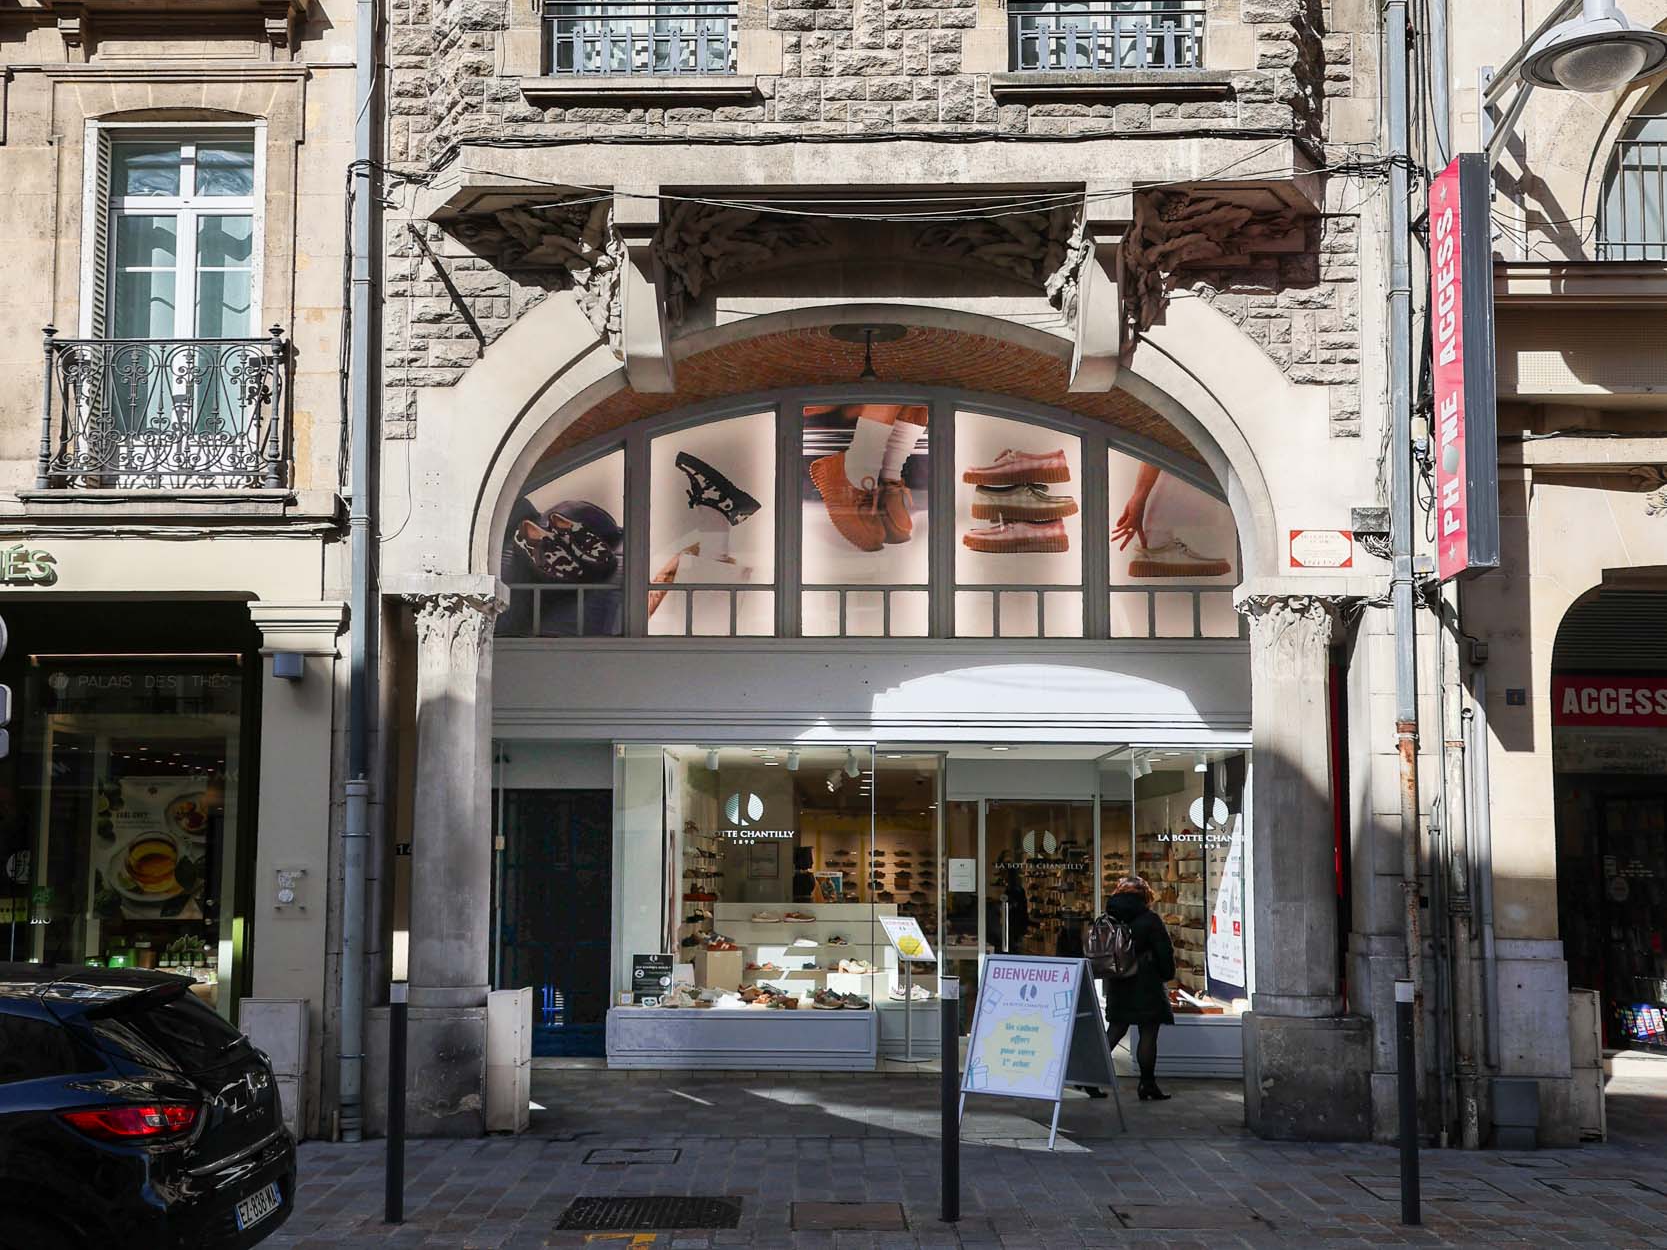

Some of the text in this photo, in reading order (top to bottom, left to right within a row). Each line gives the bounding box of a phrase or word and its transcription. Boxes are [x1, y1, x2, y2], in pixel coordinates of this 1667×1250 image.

[1436, 207, 1457, 367] ACCESS
[0, 543, 50, 579] ÉS
[78, 673, 232, 688] PALAIS DES THÉS
[1562, 687, 1667, 715] ACCESS
[740, 830, 795, 838] CHANTILLY
[1157, 834, 1169, 842] LA
[1172, 834, 1204, 842] BOTTE
[992, 966, 1070, 983] BIENVENUE À
